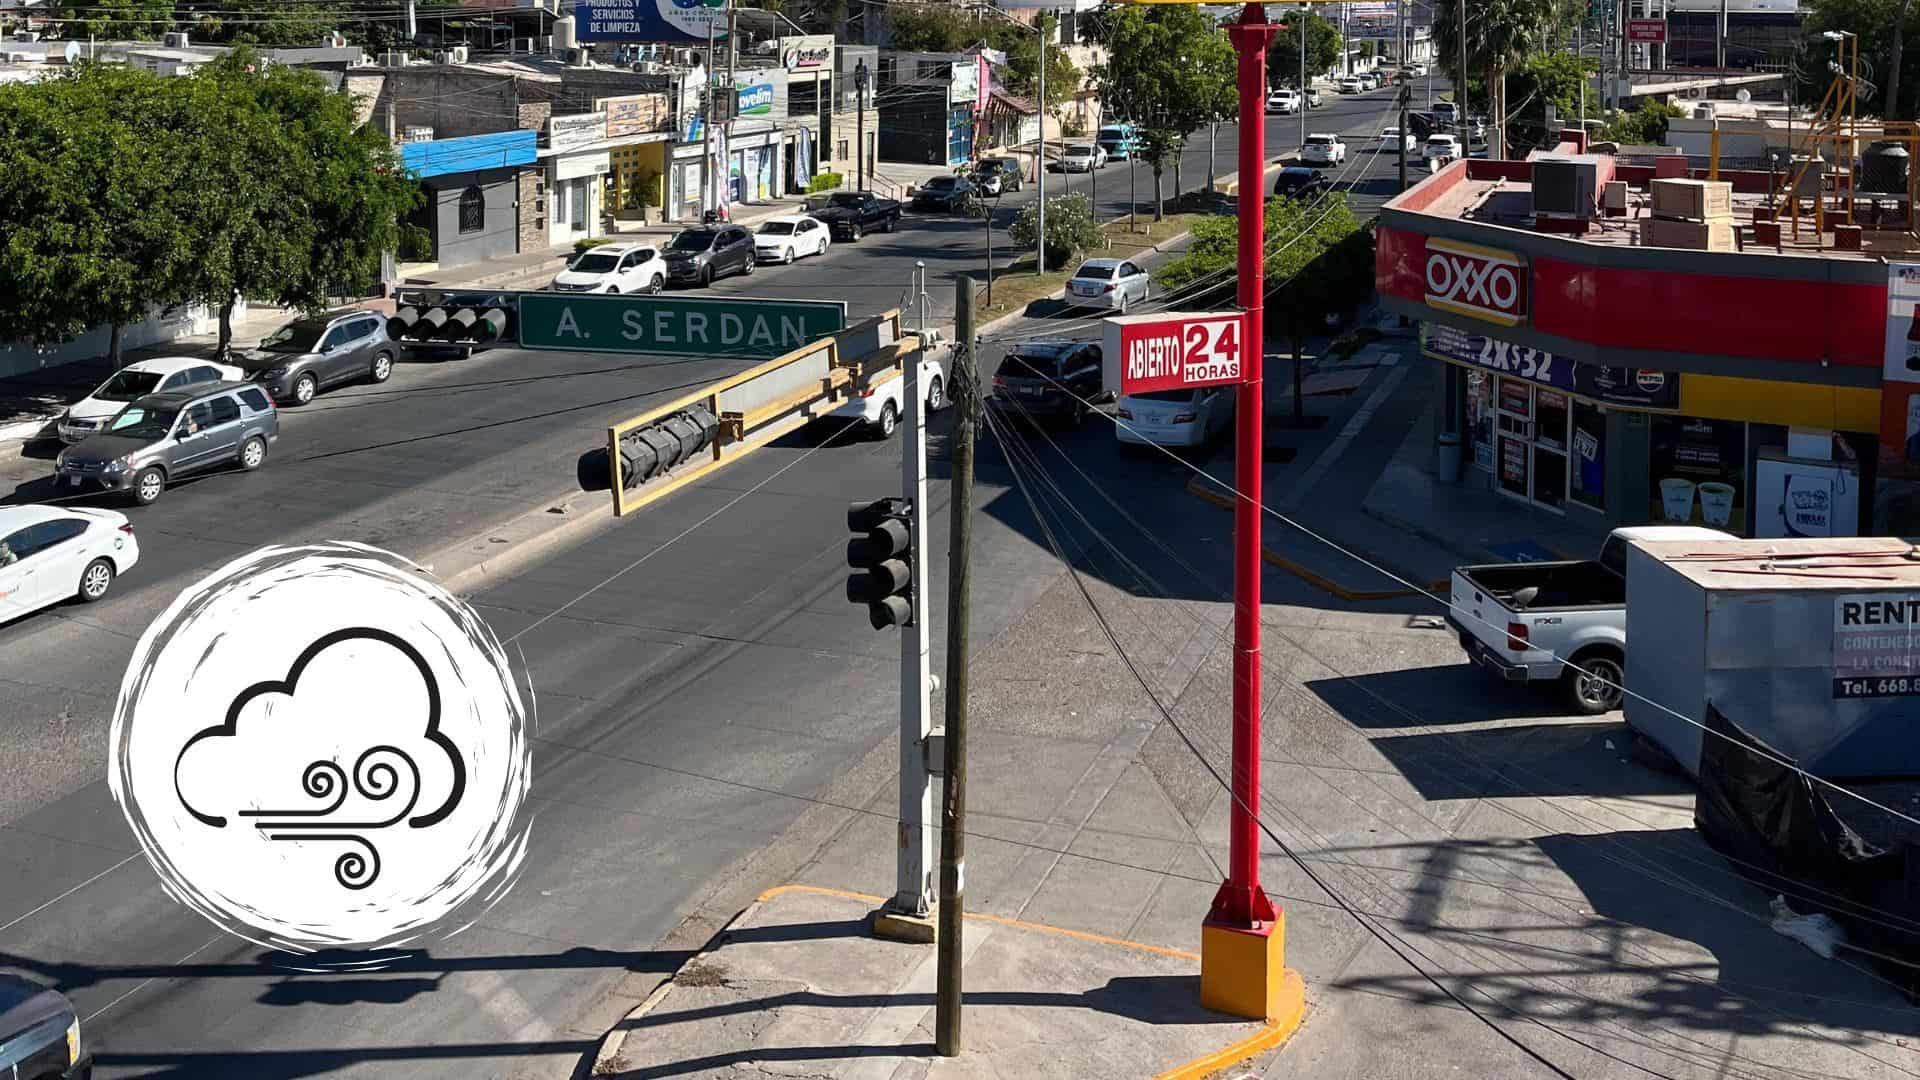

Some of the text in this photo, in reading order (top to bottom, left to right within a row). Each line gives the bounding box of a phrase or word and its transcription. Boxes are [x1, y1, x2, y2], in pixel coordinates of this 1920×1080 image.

[585, 0, 633, 8] PRODUCTOS
[592, 9, 635, 19] SERVICIOS
[590, 22, 641, 33] DE LIMPIEZA
[739, 87, 772, 108] ovelim
[1426, 254, 1517, 309] OXXO
[555, 306, 806, 346] A. SERDAN
[1185, 323, 1239, 364] 24
[1127, 335, 1180, 380] ABIERTO
[1185, 363, 1239, 380] HORAS
[1853, 655, 1920, 670] LA CONST
[1842, 680, 1873, 695] Tel.
